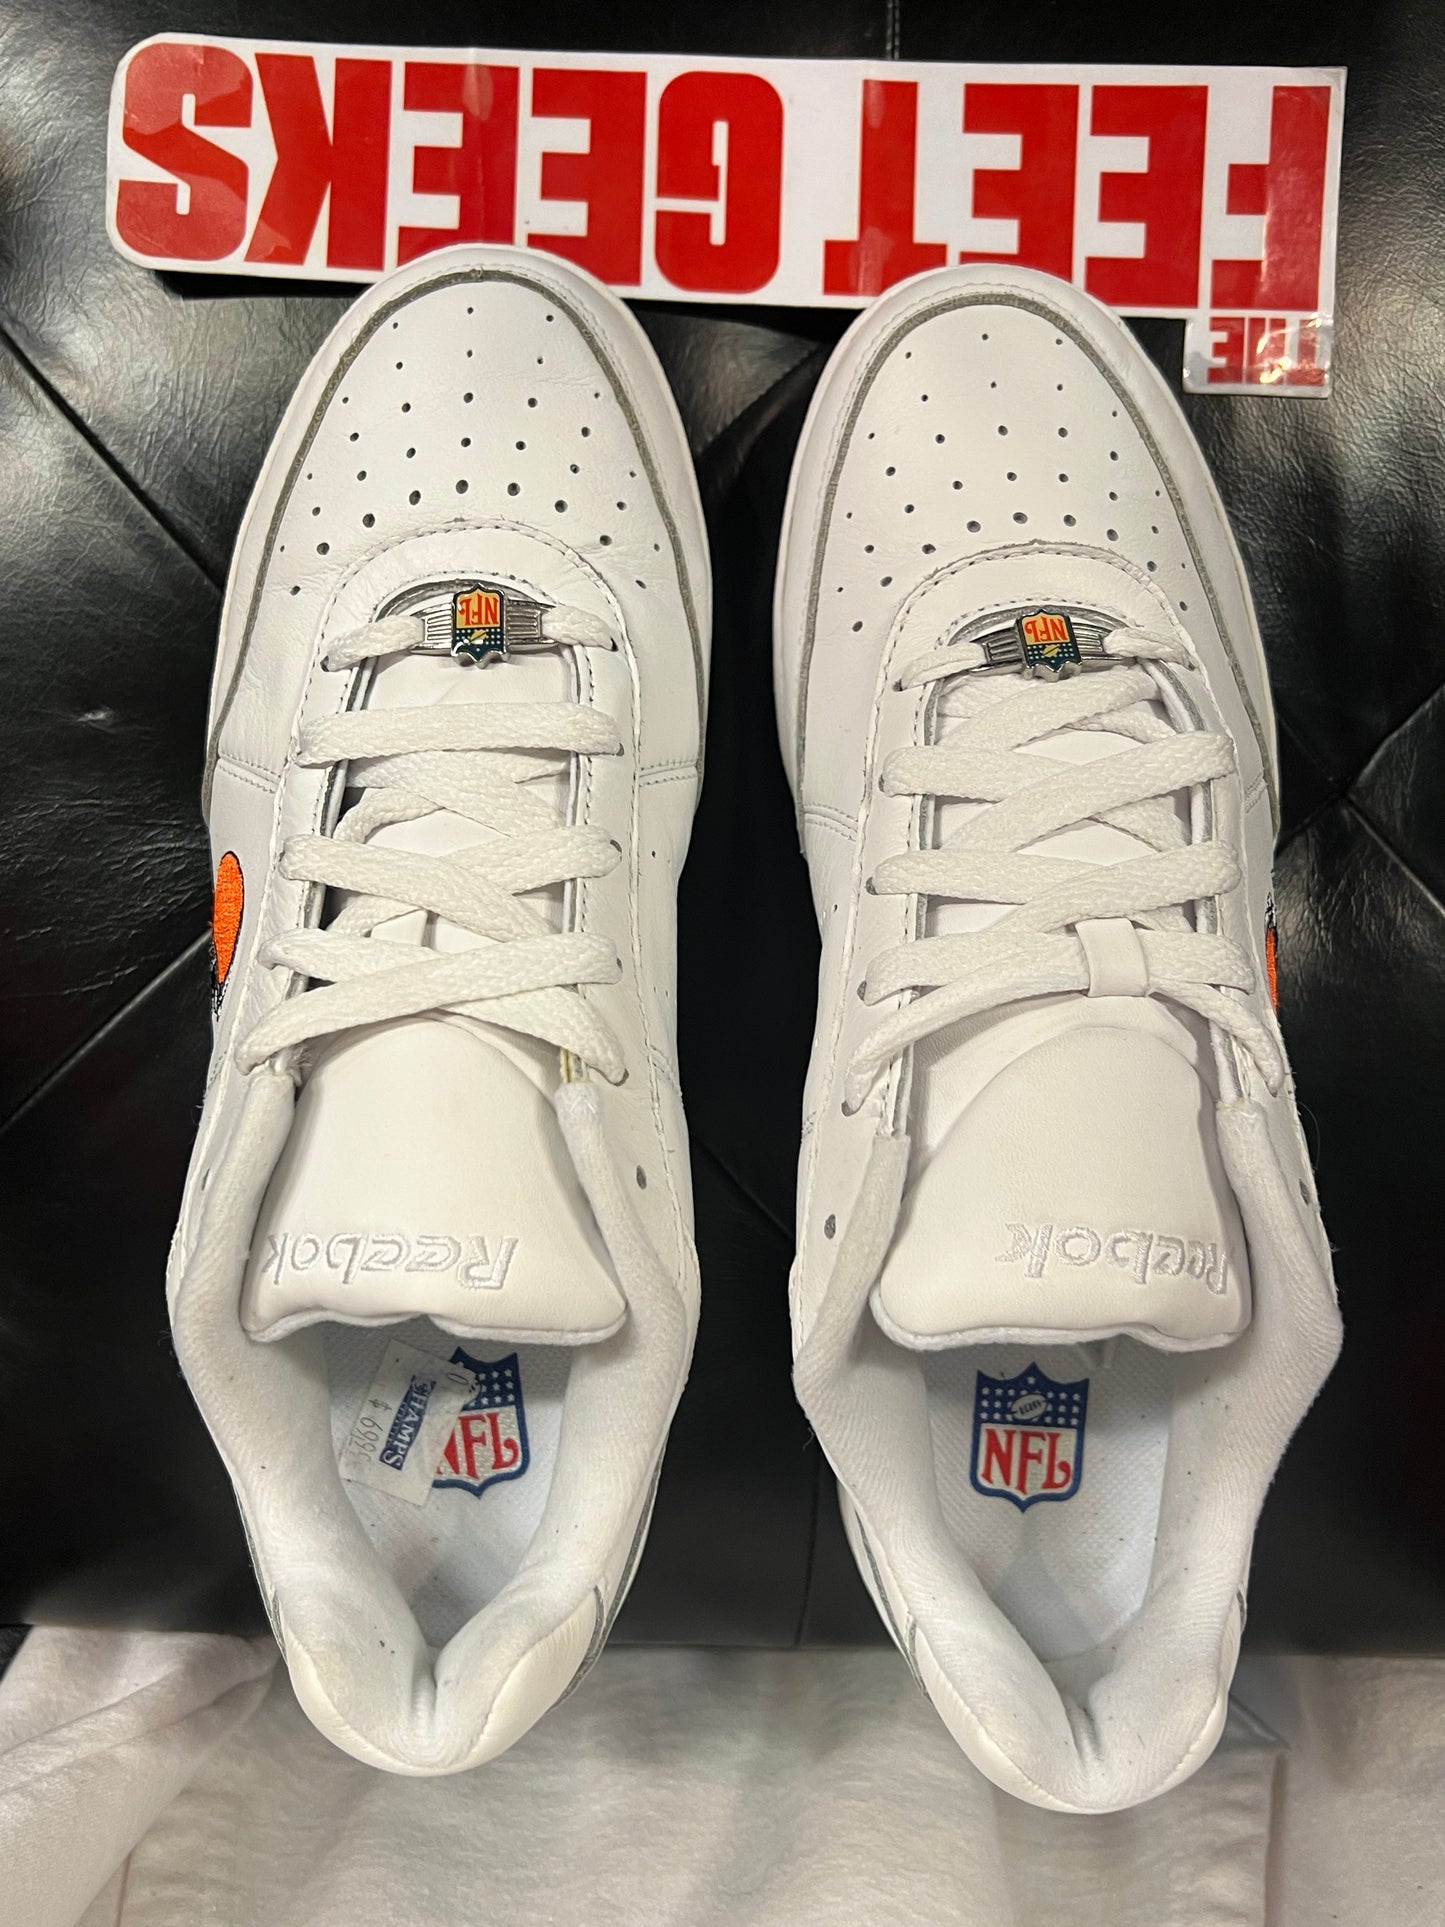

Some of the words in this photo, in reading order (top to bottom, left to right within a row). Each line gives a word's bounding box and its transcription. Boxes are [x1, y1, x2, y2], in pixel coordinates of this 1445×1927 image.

[116, 42, 784, 293] GEEKS
[823, 79, 1331, 310] FEET
[1207, 317, 1325, 386] THE
[457, 594, 499, 626] NFL
[1023, 616, 1067, 643] NFL
[261, 1233, 519, 1291] Reebok
[995, 1223, 1228, 1296] Reebok
[980, 1428, 1073, 1495] NFL
